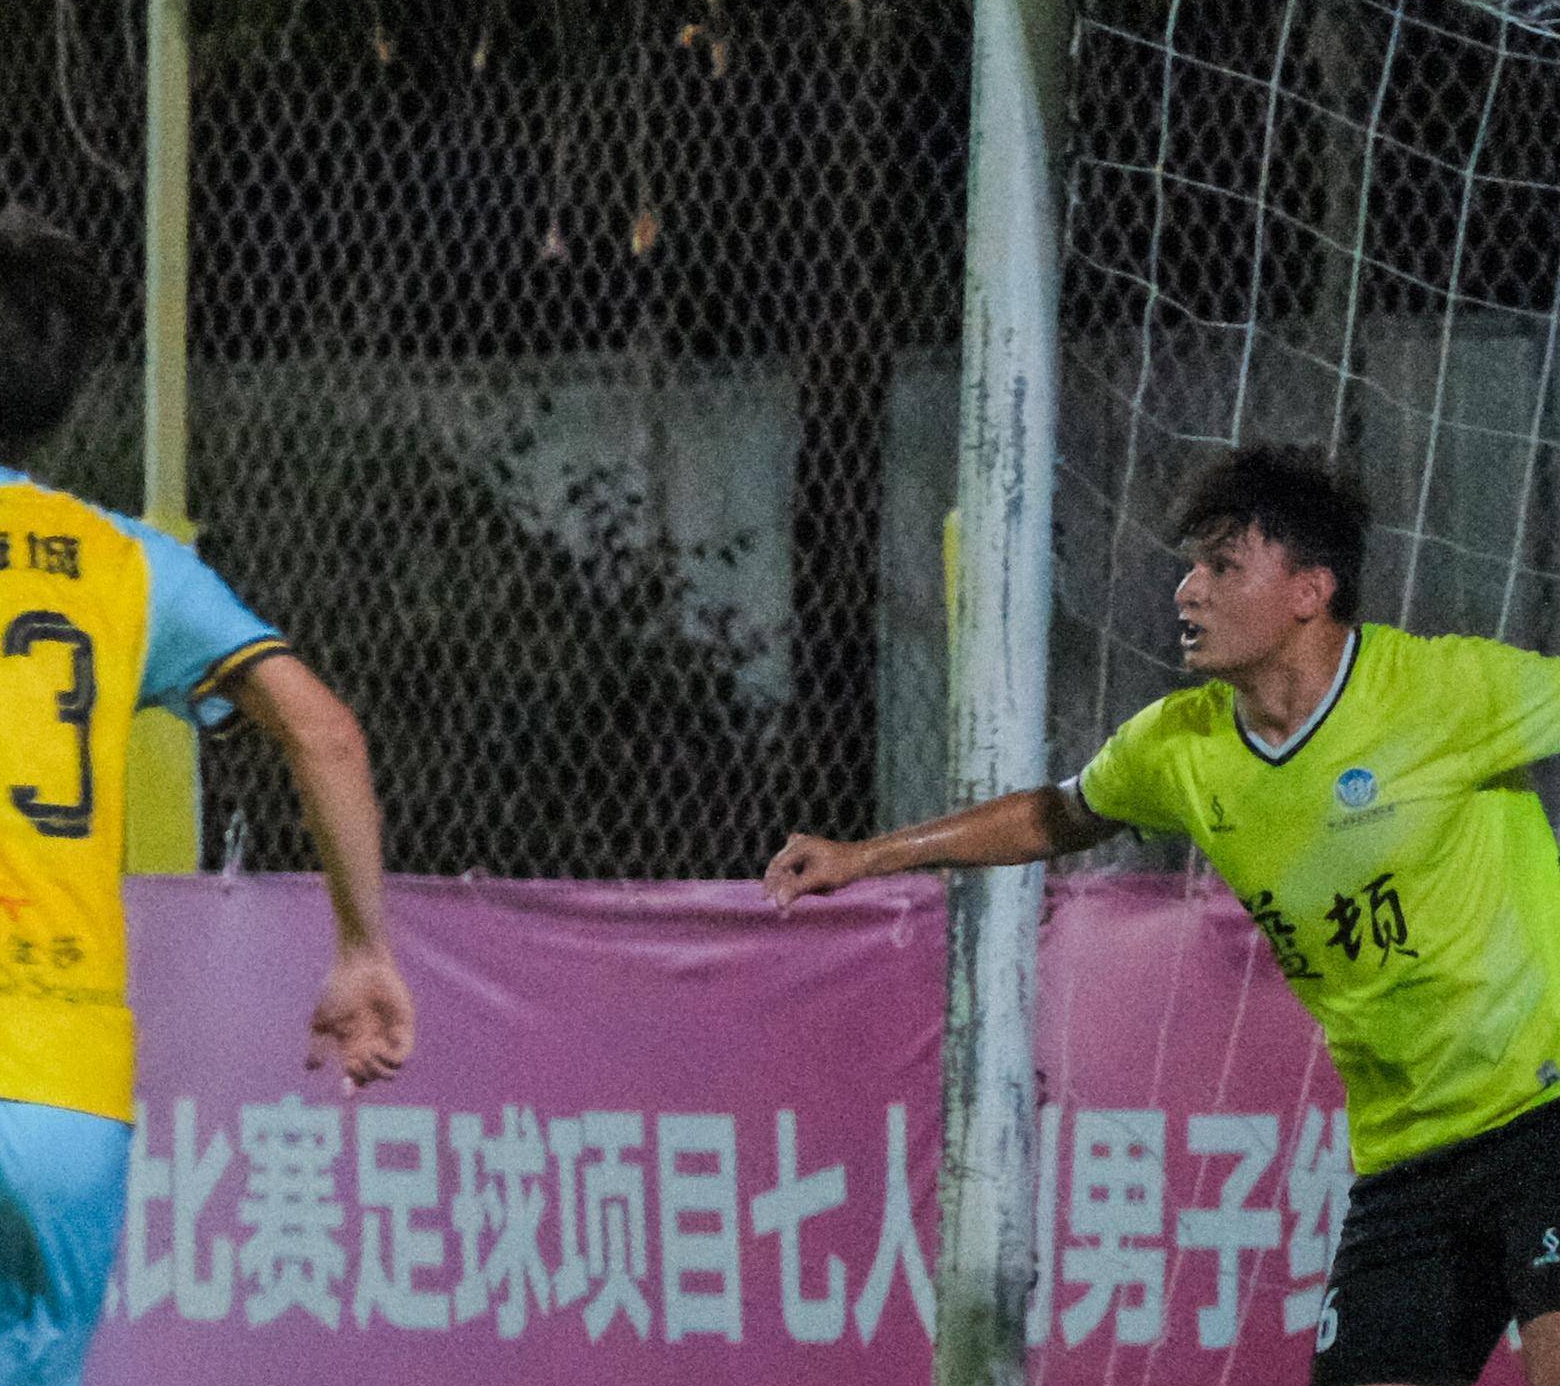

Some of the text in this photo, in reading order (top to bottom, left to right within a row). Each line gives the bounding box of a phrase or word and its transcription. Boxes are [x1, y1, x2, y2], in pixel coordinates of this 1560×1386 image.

[123, 1091, 1354, 1351] 比赛足球项目七人男子
